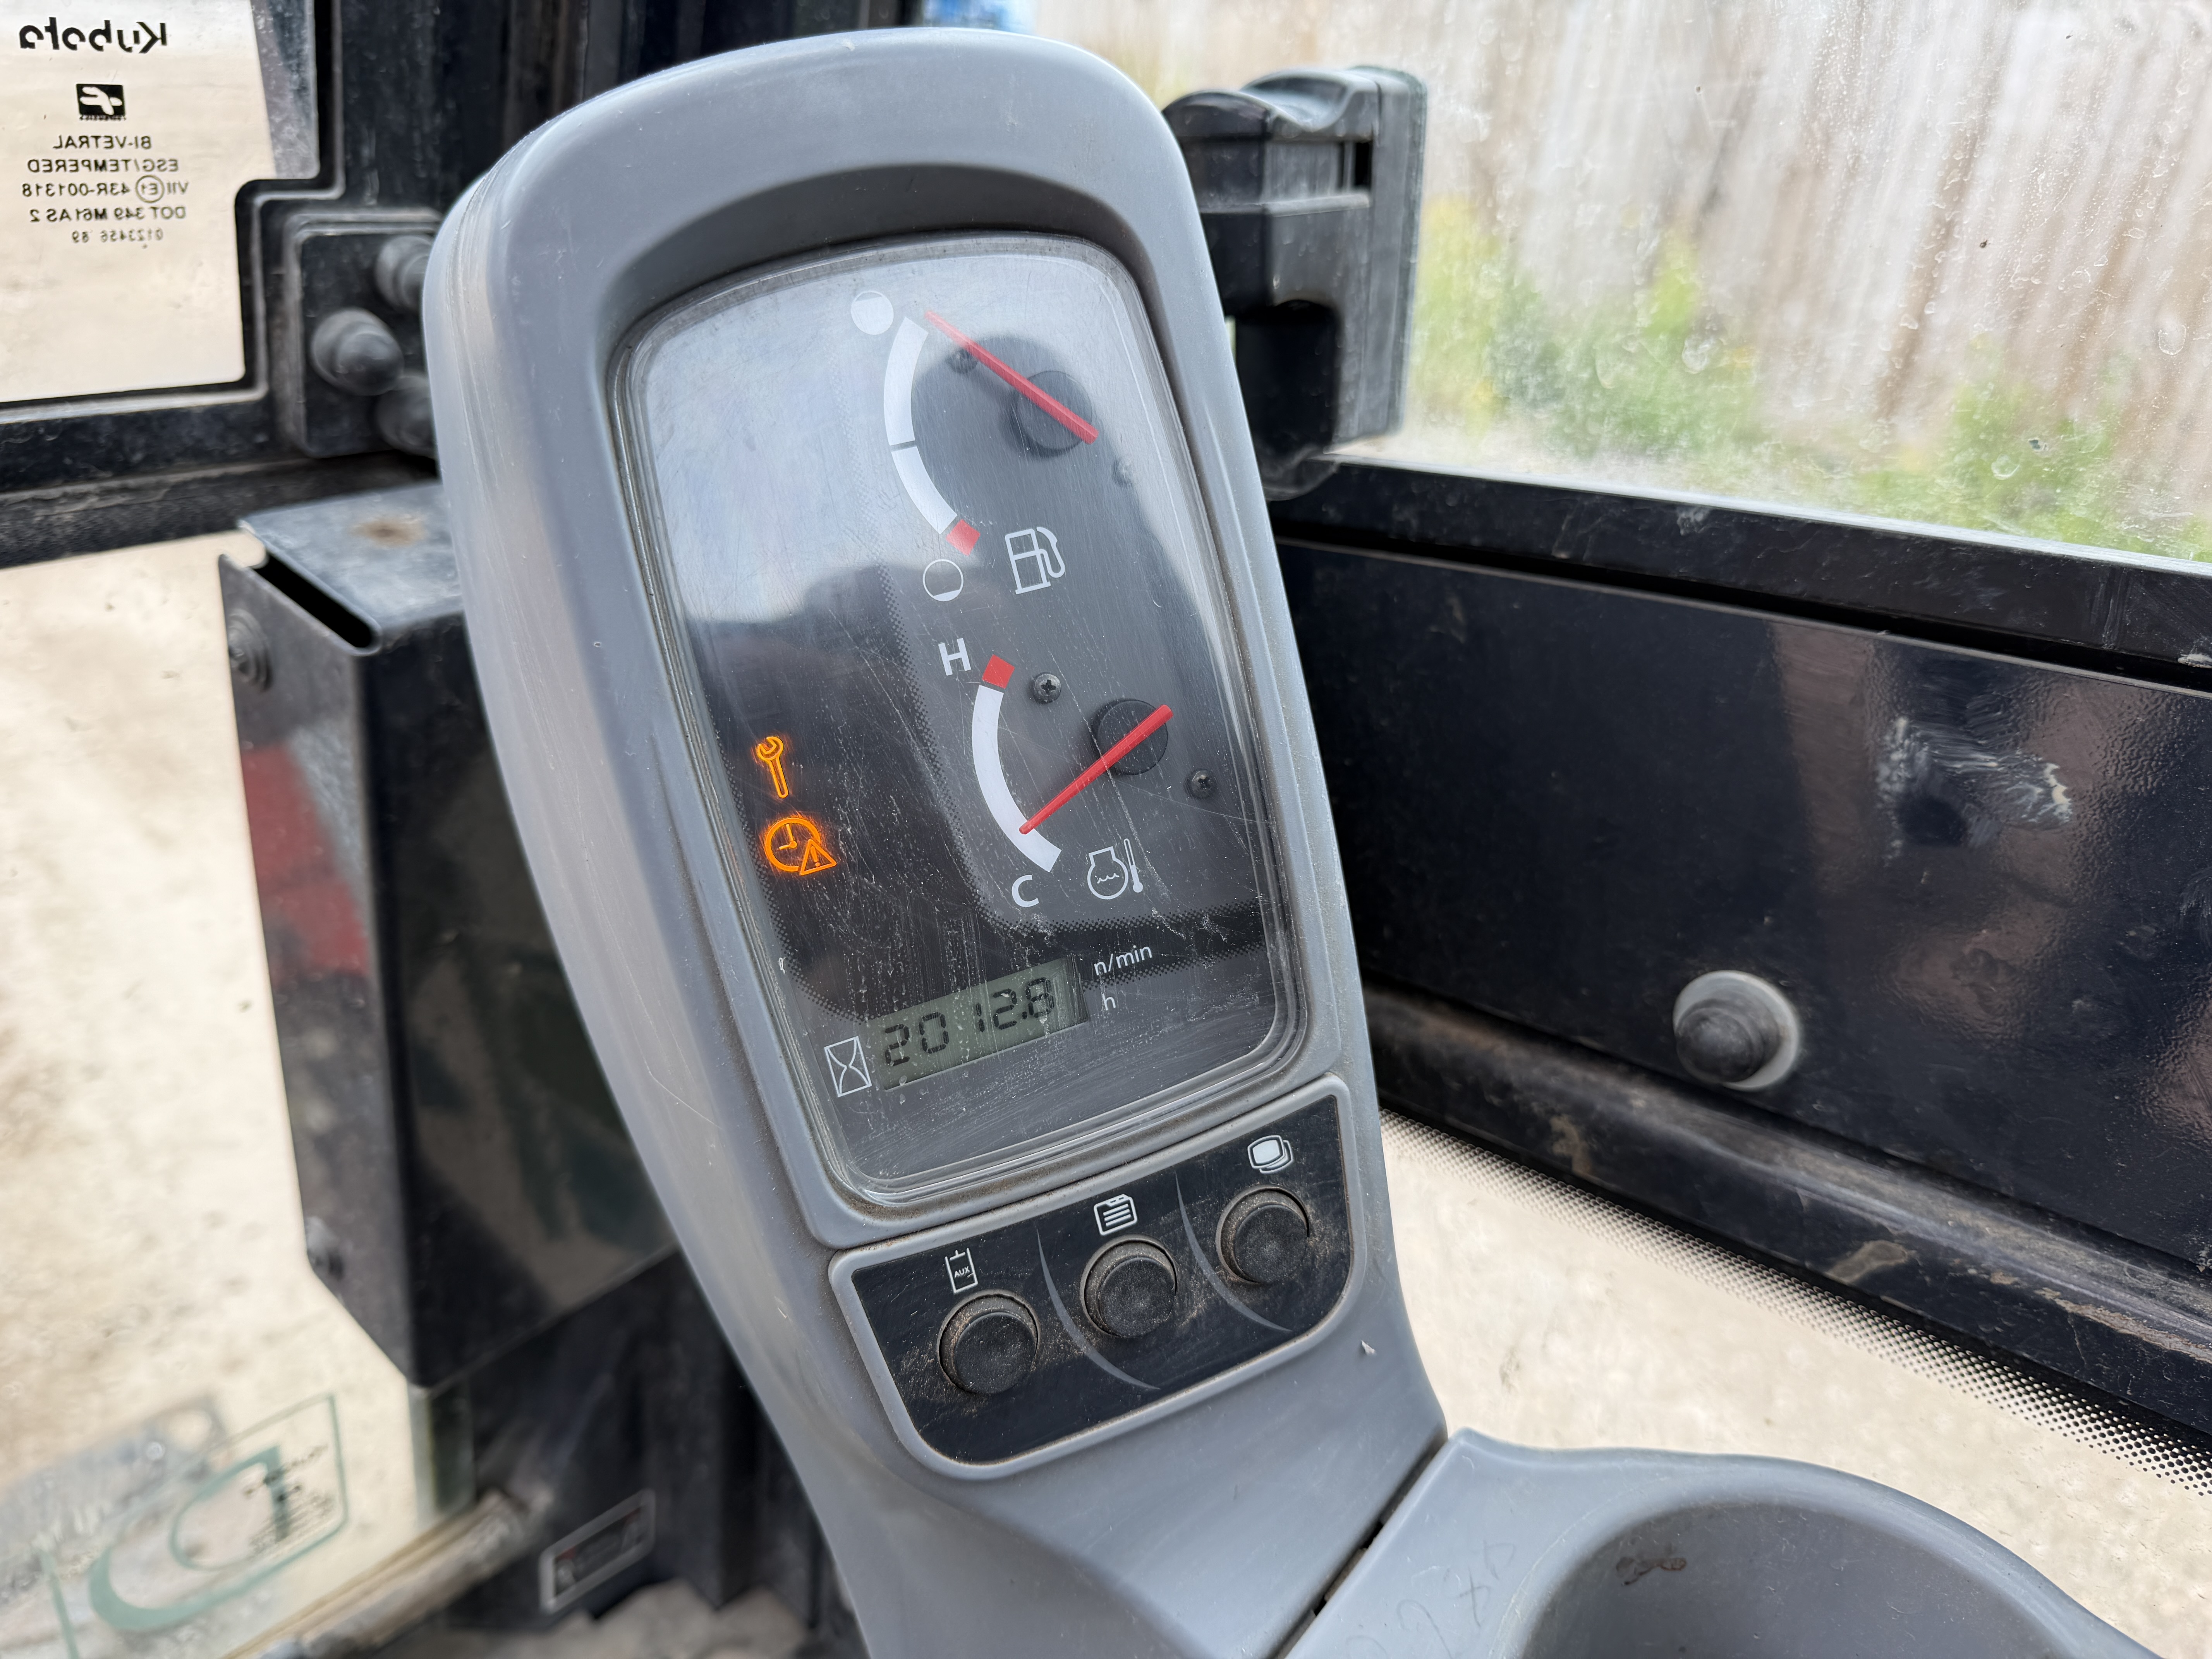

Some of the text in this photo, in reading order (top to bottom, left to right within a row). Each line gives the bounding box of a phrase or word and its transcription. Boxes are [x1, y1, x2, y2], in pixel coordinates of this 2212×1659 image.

[938, 638, 971, 676] H
[1012, 874, 1039, 907] C
[1094, 944, 1153, 976] n/min
[1103, 993, 1115, 1011] h
[884, 976, 1054, 1066] 2012.8
[954, 1266, 970, 1278] AUX
